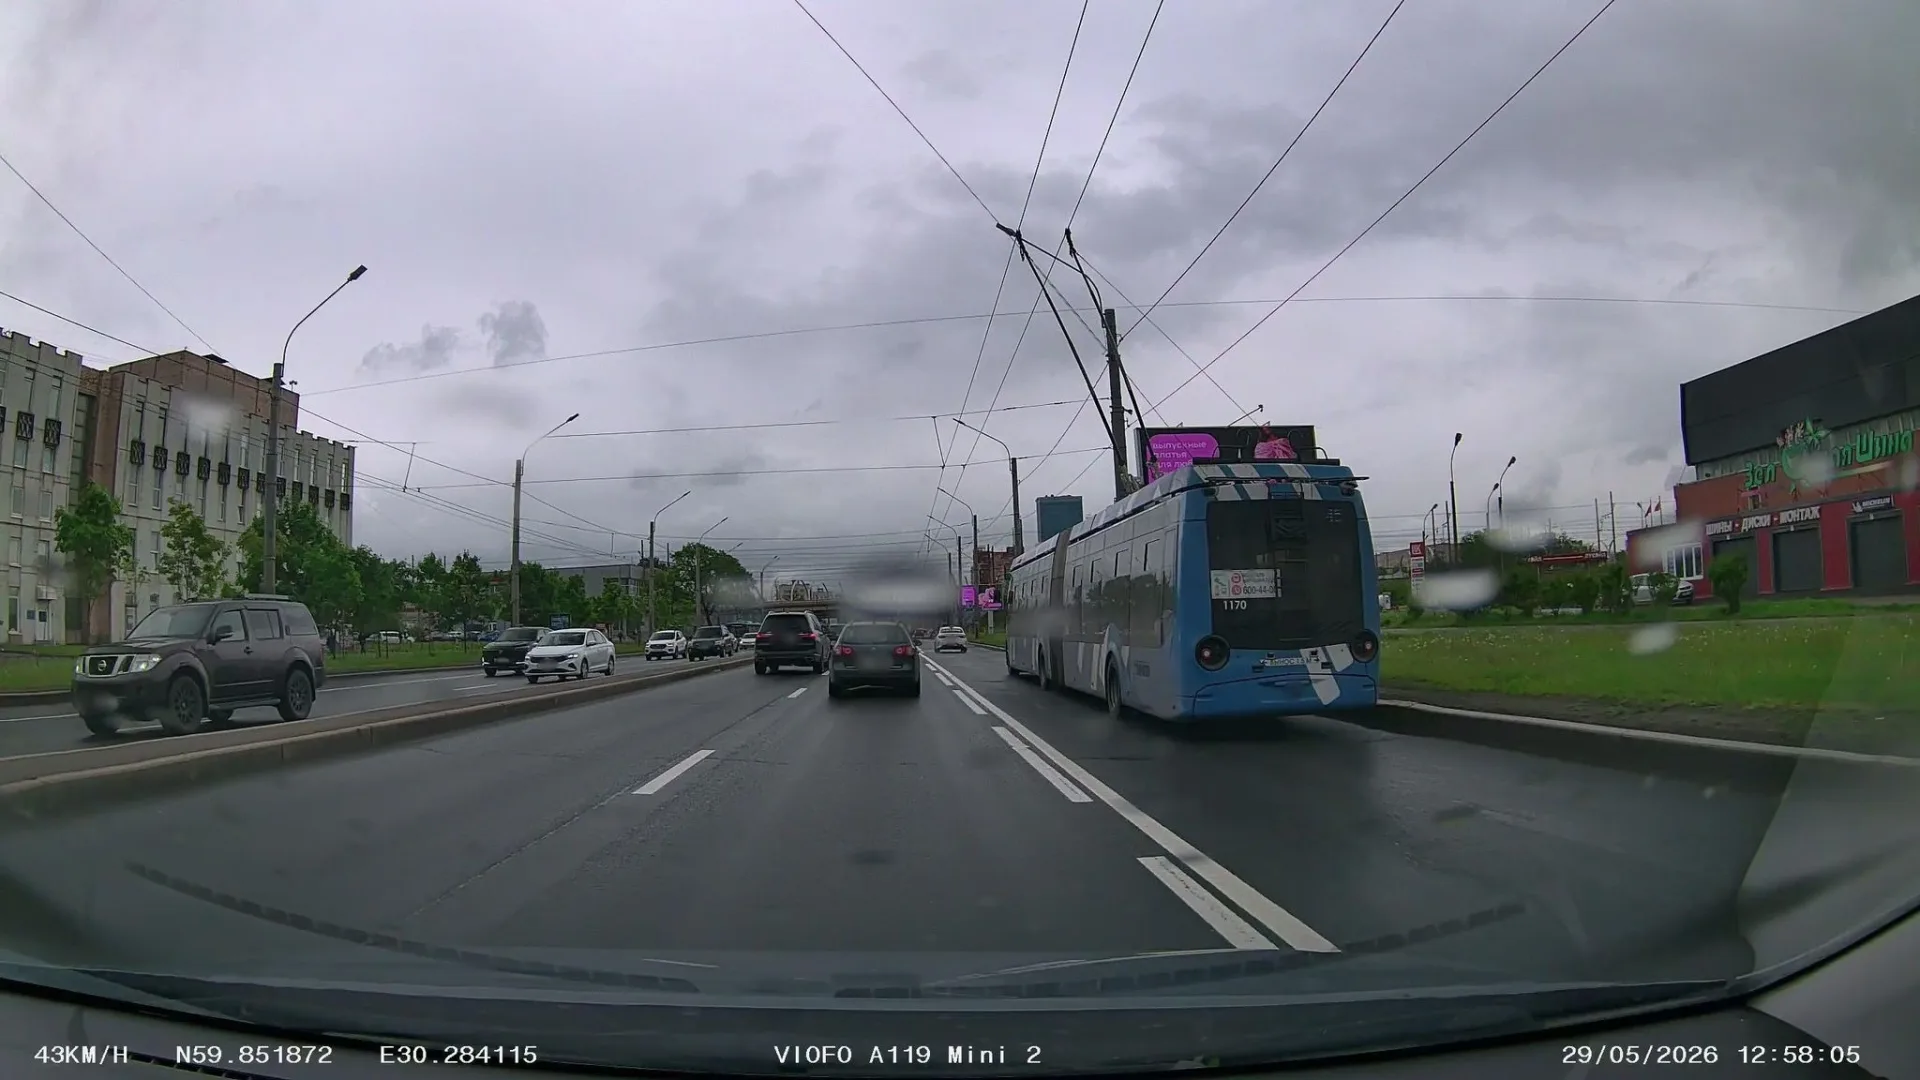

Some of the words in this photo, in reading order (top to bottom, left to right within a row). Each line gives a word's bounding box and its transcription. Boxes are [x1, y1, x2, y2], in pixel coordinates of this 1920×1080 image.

[1705, 521, 1733, 536] ШИНЫ
[1741, 513, 1771, 533] ДИСКИ
[1779, 506, 1821, 525] МОНТАЖ
[1223, 600, 1247, 610] 1170
